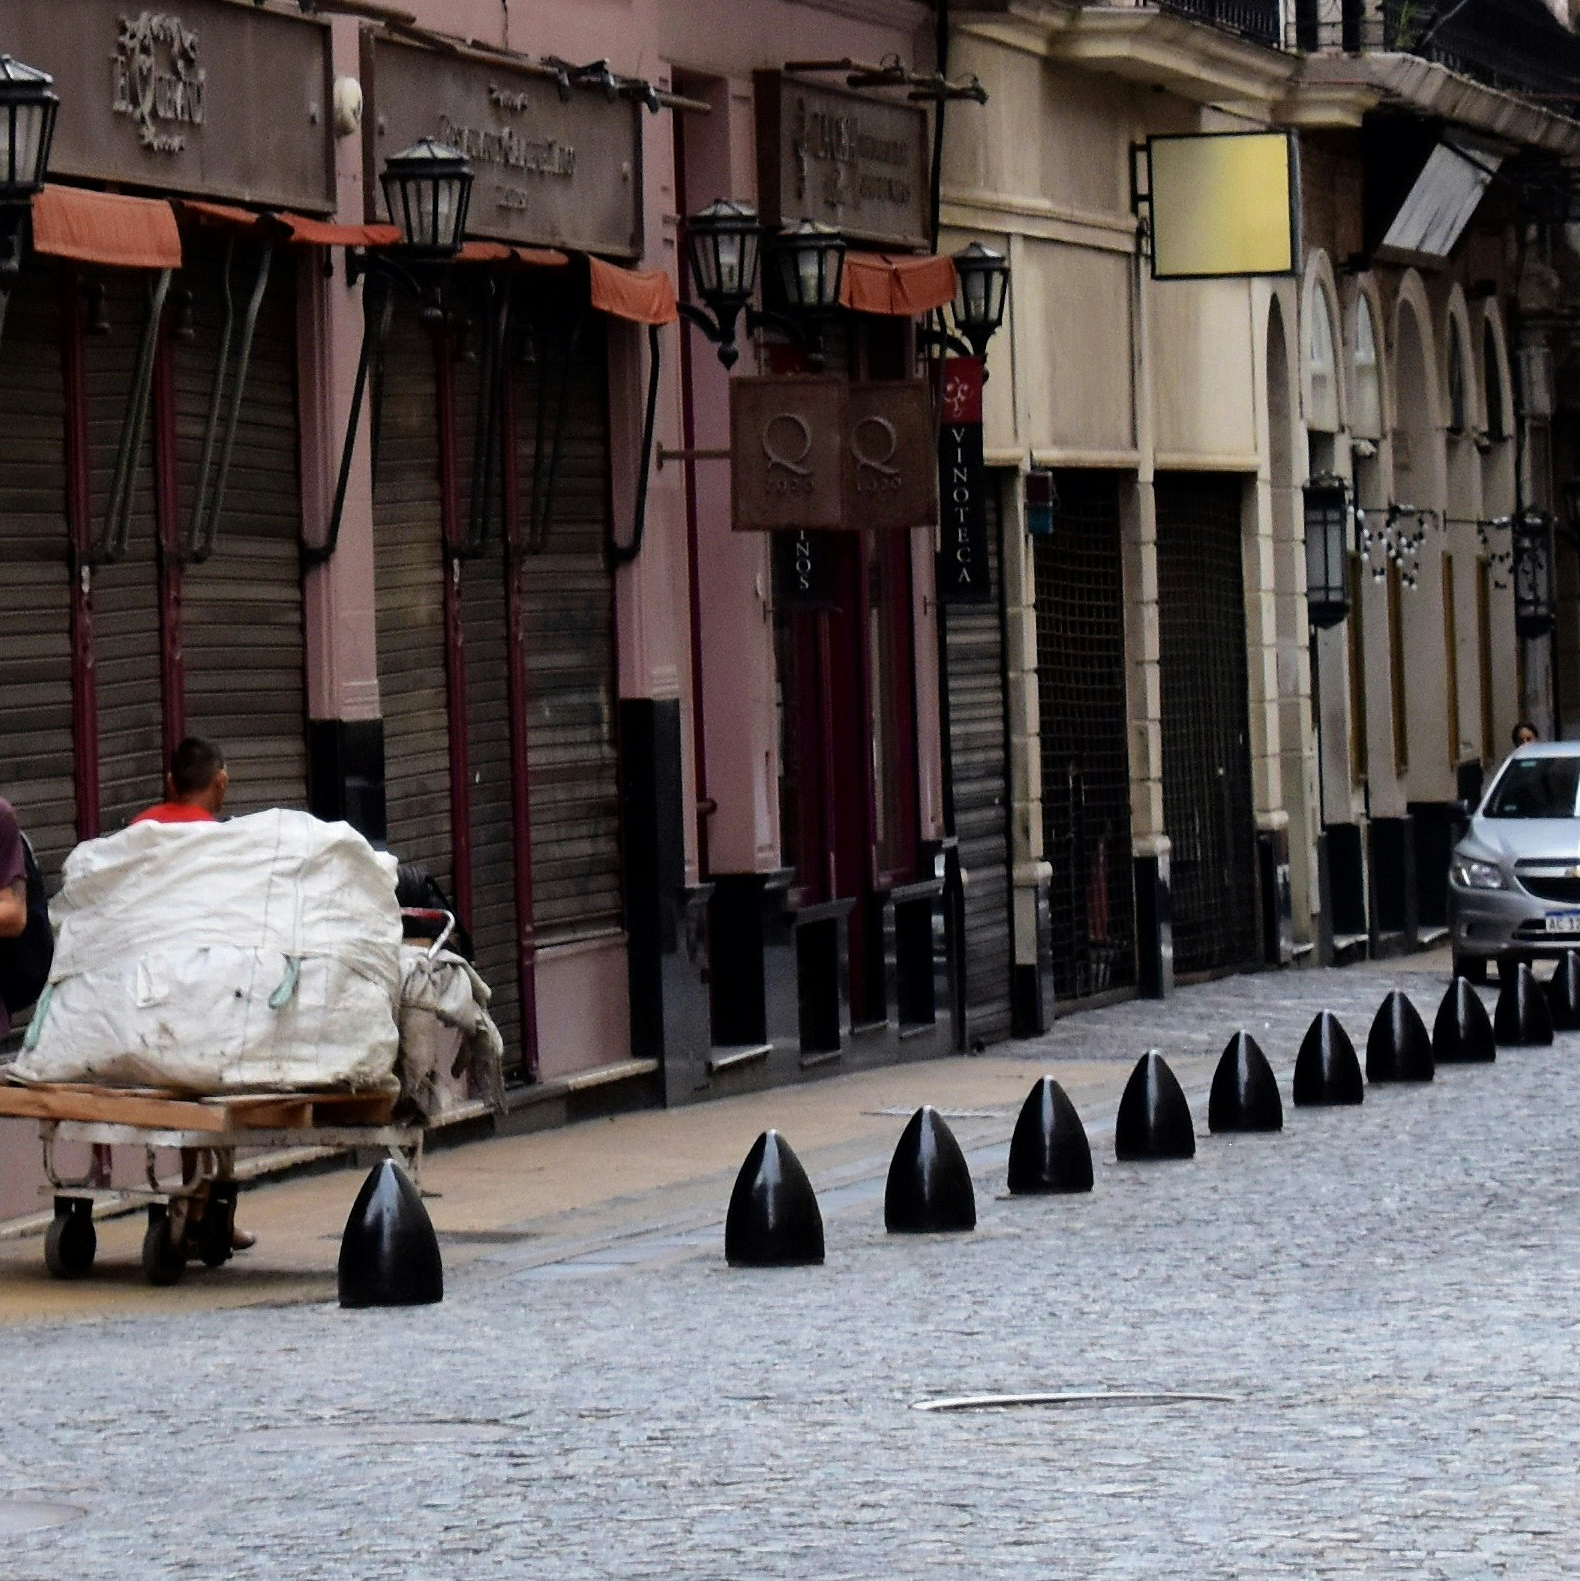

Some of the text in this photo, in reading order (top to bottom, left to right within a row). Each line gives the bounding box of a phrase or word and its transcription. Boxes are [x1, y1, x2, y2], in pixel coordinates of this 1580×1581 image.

[761, 412, 814, 476] Q
[850, 415, 901, 476] Q
[951, 427, 973, 584] VINOTECA
[795, 529, 812, 590] INOS
